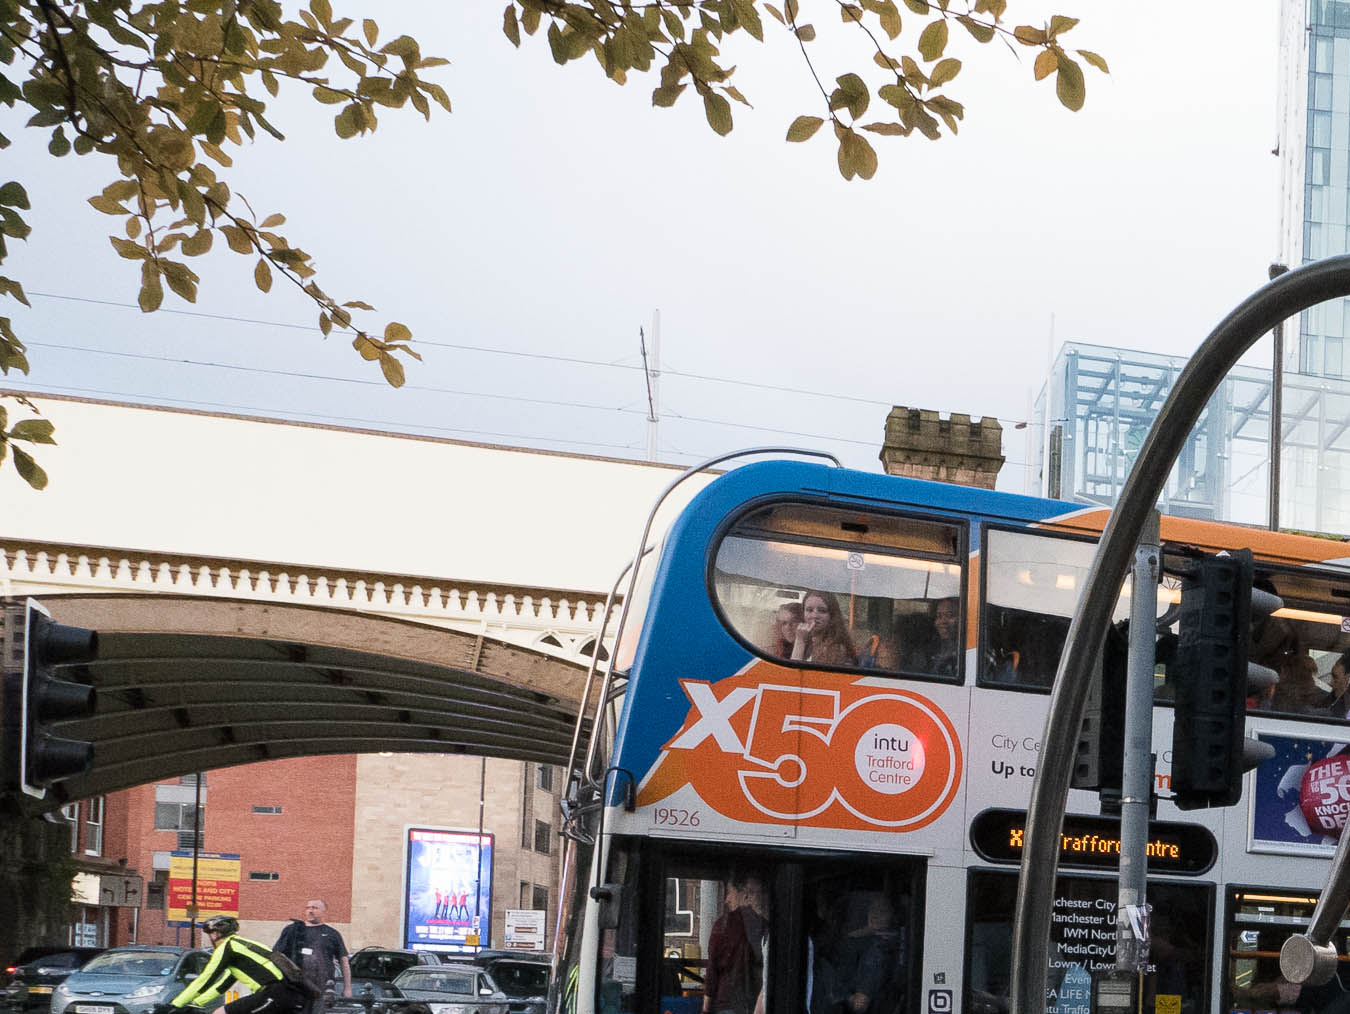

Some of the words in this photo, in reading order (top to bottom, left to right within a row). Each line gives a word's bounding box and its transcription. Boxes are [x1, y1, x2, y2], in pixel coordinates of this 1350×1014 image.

[874, 732, 909, 752] intu
[991, 734, 1018, 751] City
[668, 681, 957, 828] X50
[866, 754, 914, 771] Trafford
[869, 770, 912, 785] Centre
[991, 761, 1015, 778] Up
[1020, 762, 1036, 777] to
[1309, 761, 1344, 782] THE
[654, 808, 701, 827] 19526
[1095, 899, 1116, 910] City
[1063, 927, 1088, 940] IWM
[1048, 957, 1082, 970] Lowry
[1060, 988, 1083, 1000] LIFE
